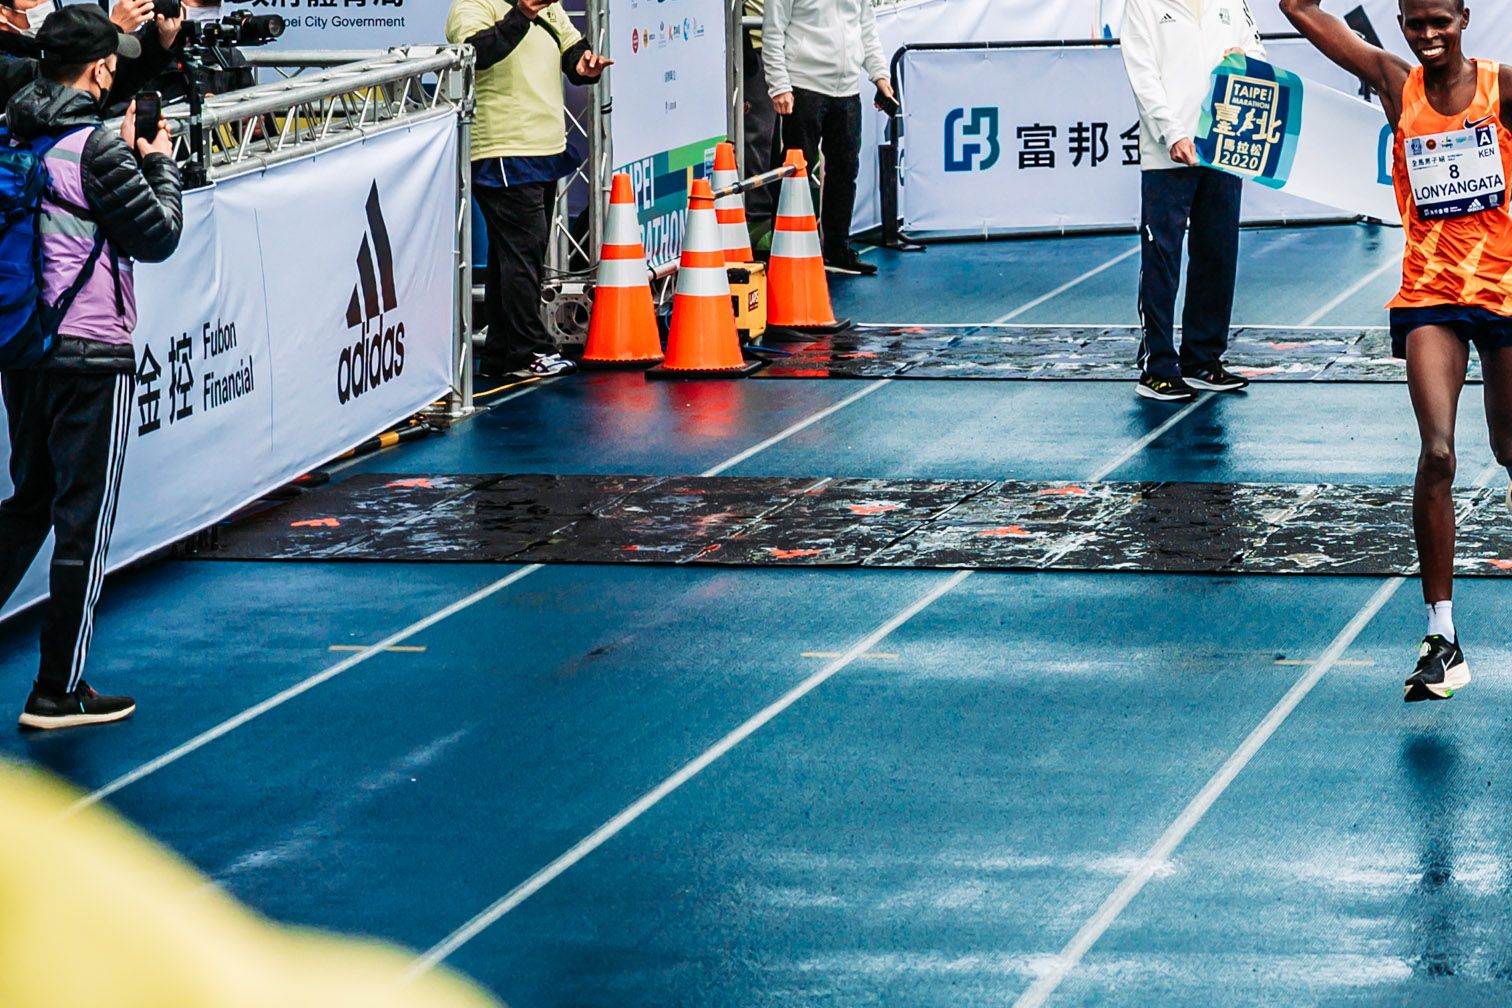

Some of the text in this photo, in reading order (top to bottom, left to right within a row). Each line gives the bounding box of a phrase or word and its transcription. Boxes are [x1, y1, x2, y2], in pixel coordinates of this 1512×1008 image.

[304, 16, 328, 30] City
[331, 15, 405, 28] Government
[1234, 83, 1273, 103] TAIPEI
[1223, 138, 1262, 157] 馬拉松
[1479, 131, 1491, 147] A
[1220, 151, 1259, 170] 2020
[1478, 147, 1495, 159] KEN
[1448, 164, 1460, 179] 8
[1414, 174, 1503, 201] LONYANGATA
[203, 318, 237, 359] Fubon
[337, 313, 405, 405] adidas
[135, 332, 194, 437] 金控
[203, 354, 254, 411] Financial
